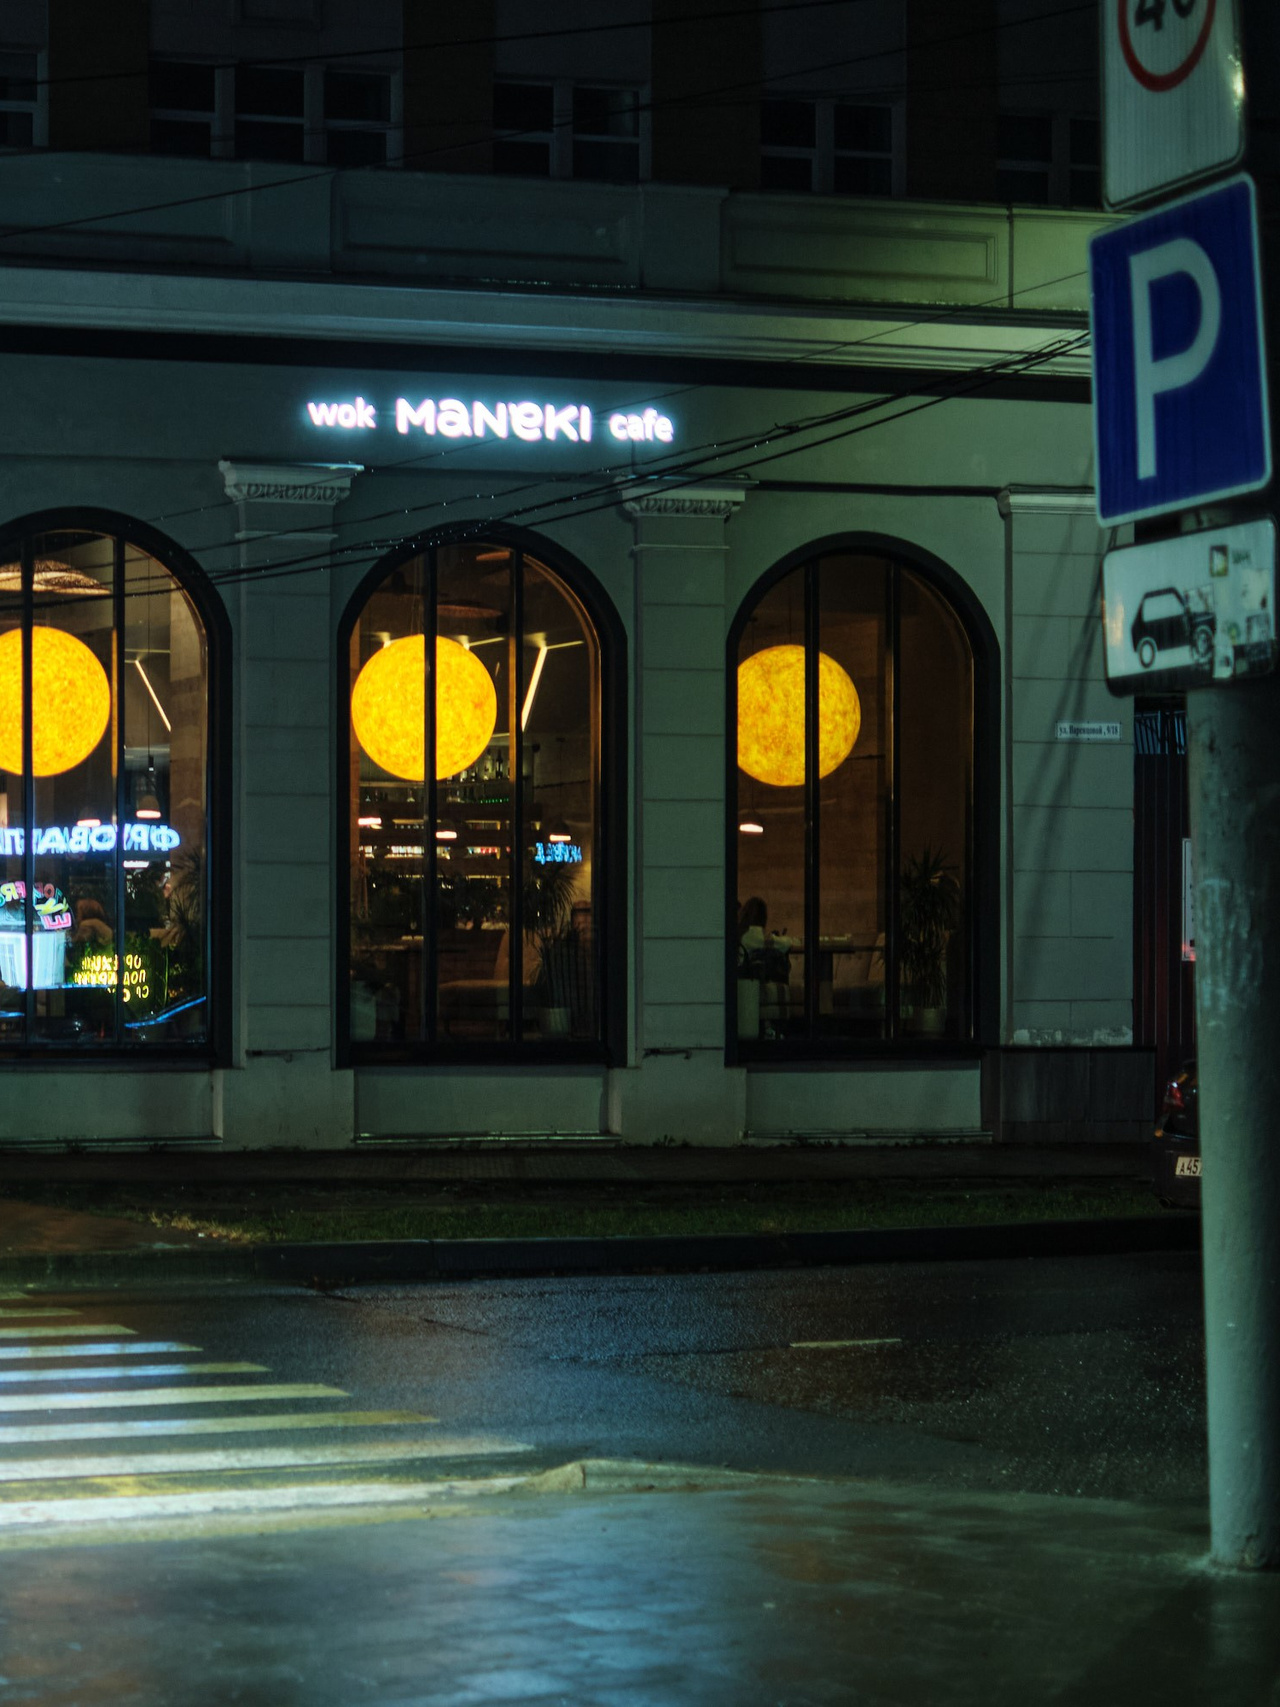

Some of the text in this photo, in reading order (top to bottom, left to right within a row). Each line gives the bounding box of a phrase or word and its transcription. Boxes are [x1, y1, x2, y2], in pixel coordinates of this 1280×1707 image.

[307, 397, 377, 429] wok
[609, 408, 674, 442] cafe
[1129, 237, 1220, 480] P
